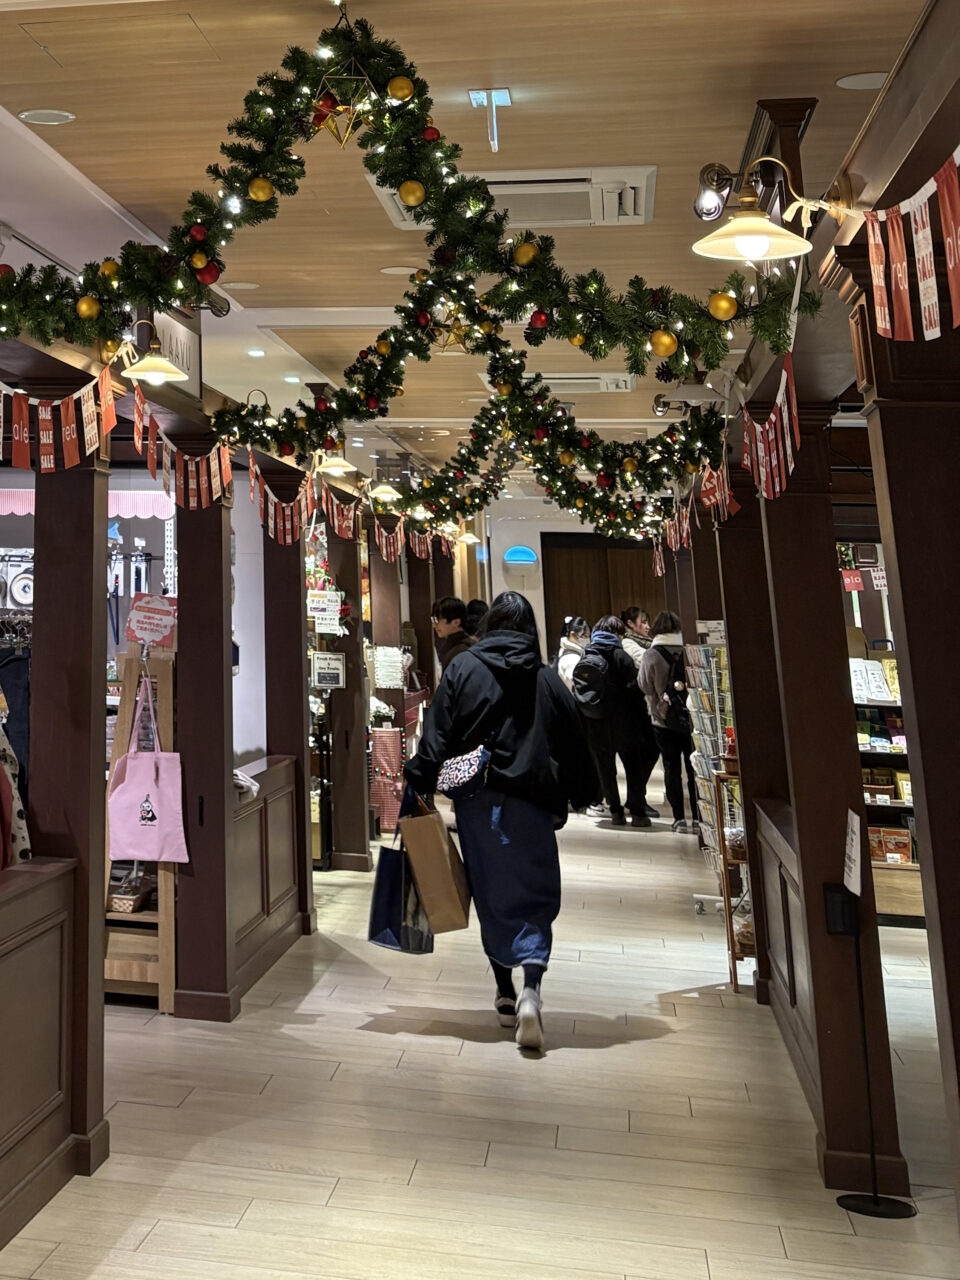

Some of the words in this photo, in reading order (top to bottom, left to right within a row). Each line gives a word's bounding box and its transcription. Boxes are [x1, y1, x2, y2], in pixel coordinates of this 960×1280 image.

[12, 420, 29, 443] ale
[40, 430, 53, 444] SALE
[62, 424, 77, 442] rea
[41, 455, 54, 468] SALE
